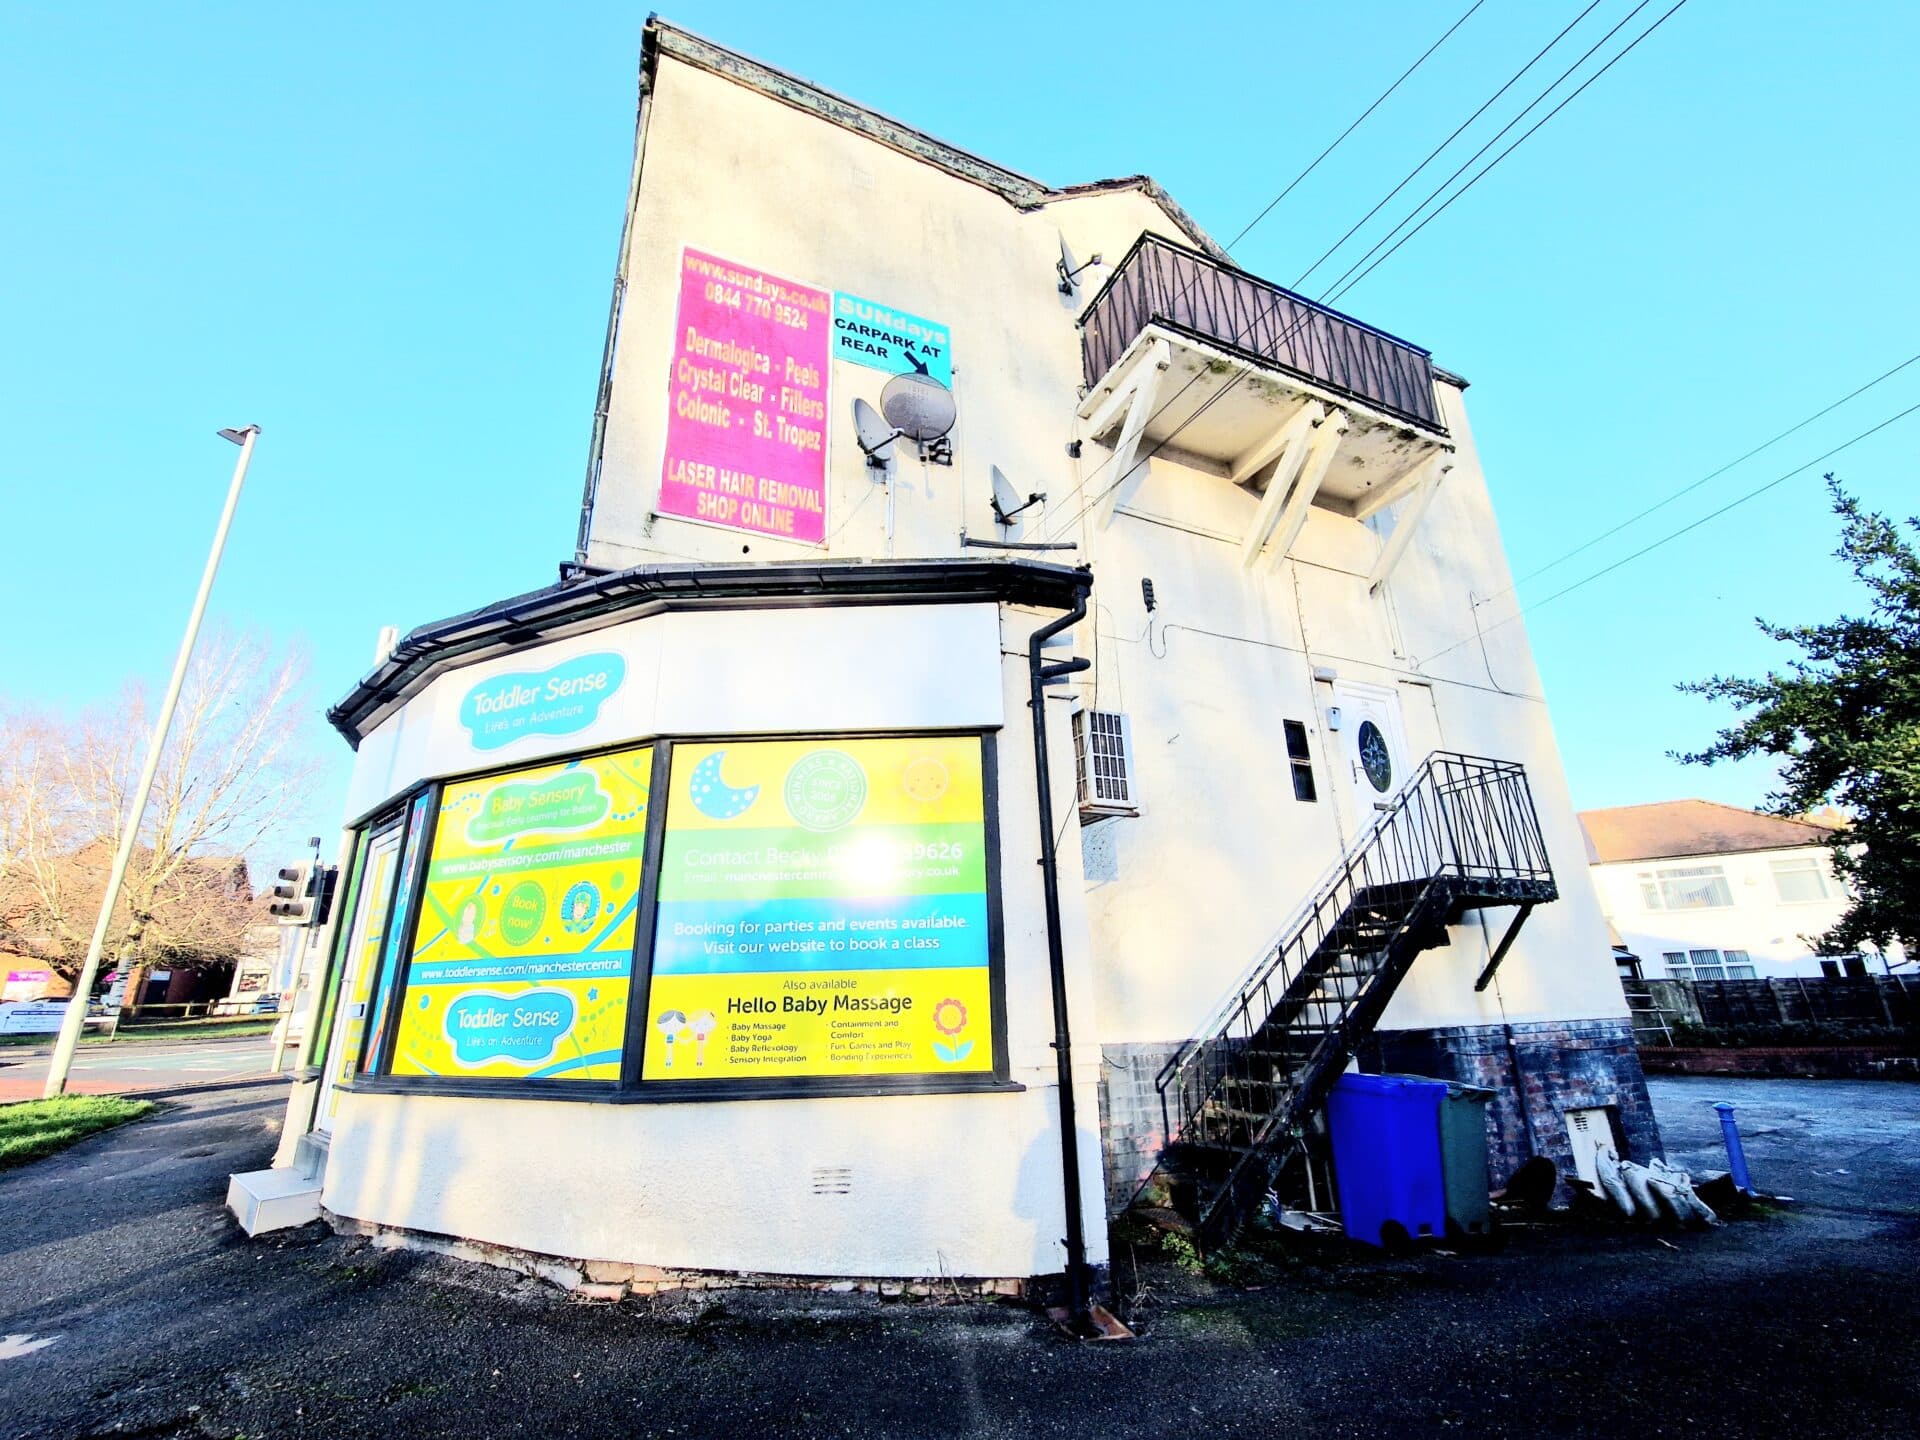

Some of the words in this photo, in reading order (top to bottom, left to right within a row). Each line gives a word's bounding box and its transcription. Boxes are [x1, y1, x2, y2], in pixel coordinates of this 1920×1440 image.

[685, 255, 828, 315] www.sundays.co.uk
[705, 280, 741, 310] 0844
[745, 292, 771, 319] 770
[774, 303, 809, 331] 9524
[838, 297, 947, 345] SUNdays
[834, 318, 916, 351] CARPARK
[921, 344, 941, 358] AT
[841, 336, 889, 359] REAR
[686, 327, 771, 376] Dermalogica
[786, 357, 820, 387] Peels
[678, 357, 728, 394] Crystal
[730, 372, 765, 404] Clear
[781, 388, 824, 421] Fillers
[677, 392, 731, 428] Colonic
[753, 413, 772, 438] St.
[777, 416, 821, 452] Tropez
[668, 457, 716, 490] LASER
[719, 467, 755, 498] HAIR
[758, 478, 823, 512] REMOVAL
[697, 492, 737, 521] SHOP
[741, 503, 795, 534] ONLINE
[474, 685, 541, 716] Toddler
[544, 672, 607, 701] Sense
[512, 716, 525, 727] an
[530, 704, 584, 724] Adventure
[492, 796, 526, 817] Baby
[528, 784, 589, 810] Sensory
[443, 841, 632, 875] www.babysensory.com/manchester
[684, 848, 761, 866] Contact
[512, 895, 538, 912] Book
[674, 921, 736, 937] Booking
[740, 920, 760, 933] for
[764, 919, 814, 936] parties
[818, 918, 845, 931] and
[849, 918, 898, 931] events
[703, 940, 735, 954] Visit
[738, 942, 764, 953] our
[768, 938, 826, 953] website
[829, 938, 845, 951] to
[849, 937, 887, 950] book
[891, 940, 899, 949] a
[904, 936, 940, 949] class
[421, 956, 623, 979] www.toddlersense.com/manchestercentral
[782, 980, 807, 990] Also
[809, 978, 858, 990] available
[727, 997, 777, 1014] Hello
[783, 996, 828, 1016] Baby
[833, 995, 912, 1014] Massage
[457, 1008, 509, 1029] Toddler
[512, 1007, 560, 1028] Sense
[731, 1023, 750, 1032] Baby
[753, 1023, 786, 1031] Massage
[831, 1020, 882, 1028] Containment
[488, 1037, 497, 1047] an
[501, 1035, 543, 1047] Adventure
[731, 1034, 750, 1042] Baby
[752, 1034, 772, 1042] Yoga
[830, 1031, 864, 1039] Comfort
[849, 1041, 876, 1050] Games
[895, 1040, 912, 1049] Play
[729, 1056, 760, 1064] Sensory
[763, 1055, 807, 1064] Integration
[730, 1045, 749, 1053] Baby
[751, 1044, 798, 1053] Reflexology
[830, 1053, 864, 1062] Bonding
